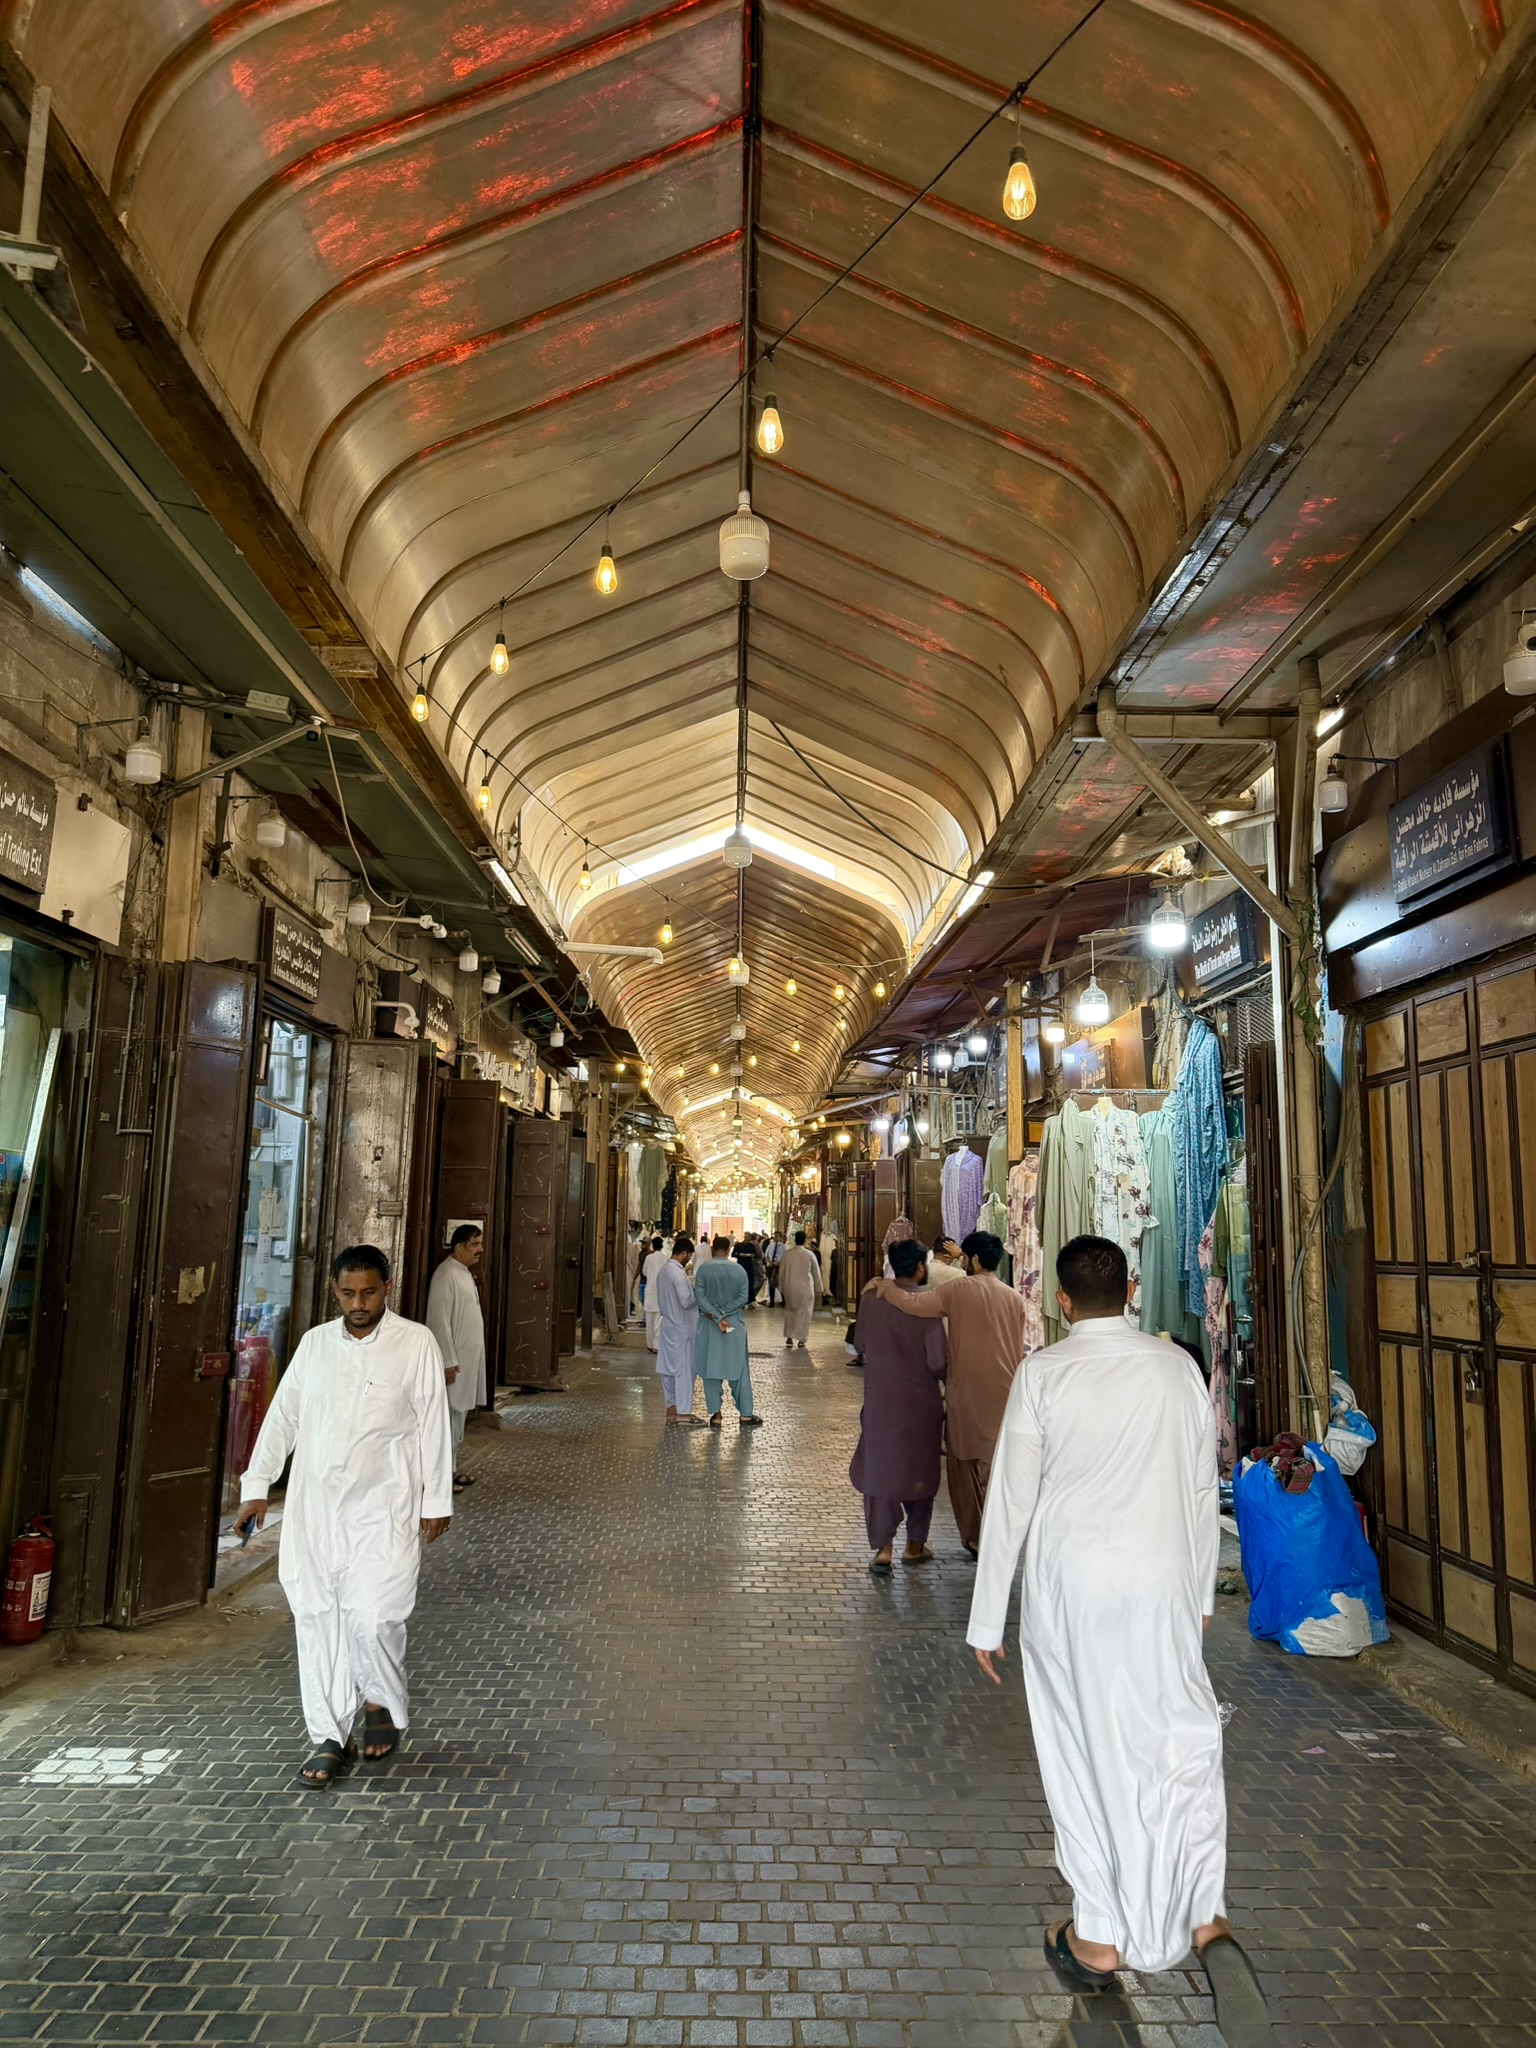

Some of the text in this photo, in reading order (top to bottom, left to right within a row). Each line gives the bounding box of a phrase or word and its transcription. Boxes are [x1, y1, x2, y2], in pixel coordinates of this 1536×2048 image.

[1452, 769, 1480, 800] مؤسسة
[15, 792, 30, 817] سالم
[30, 795, 49, 831] مؤسسة
[1416, 797, 1431, 825] خالد
[1396, 813, 1415, 844] محسن
[1451, 801, 1486, 850] الزهراني
[6, 834, 30, 876] Trading
[1465, 843, 1473, 859] Fine
[1473, 837, 1489, 856] Fabrics
